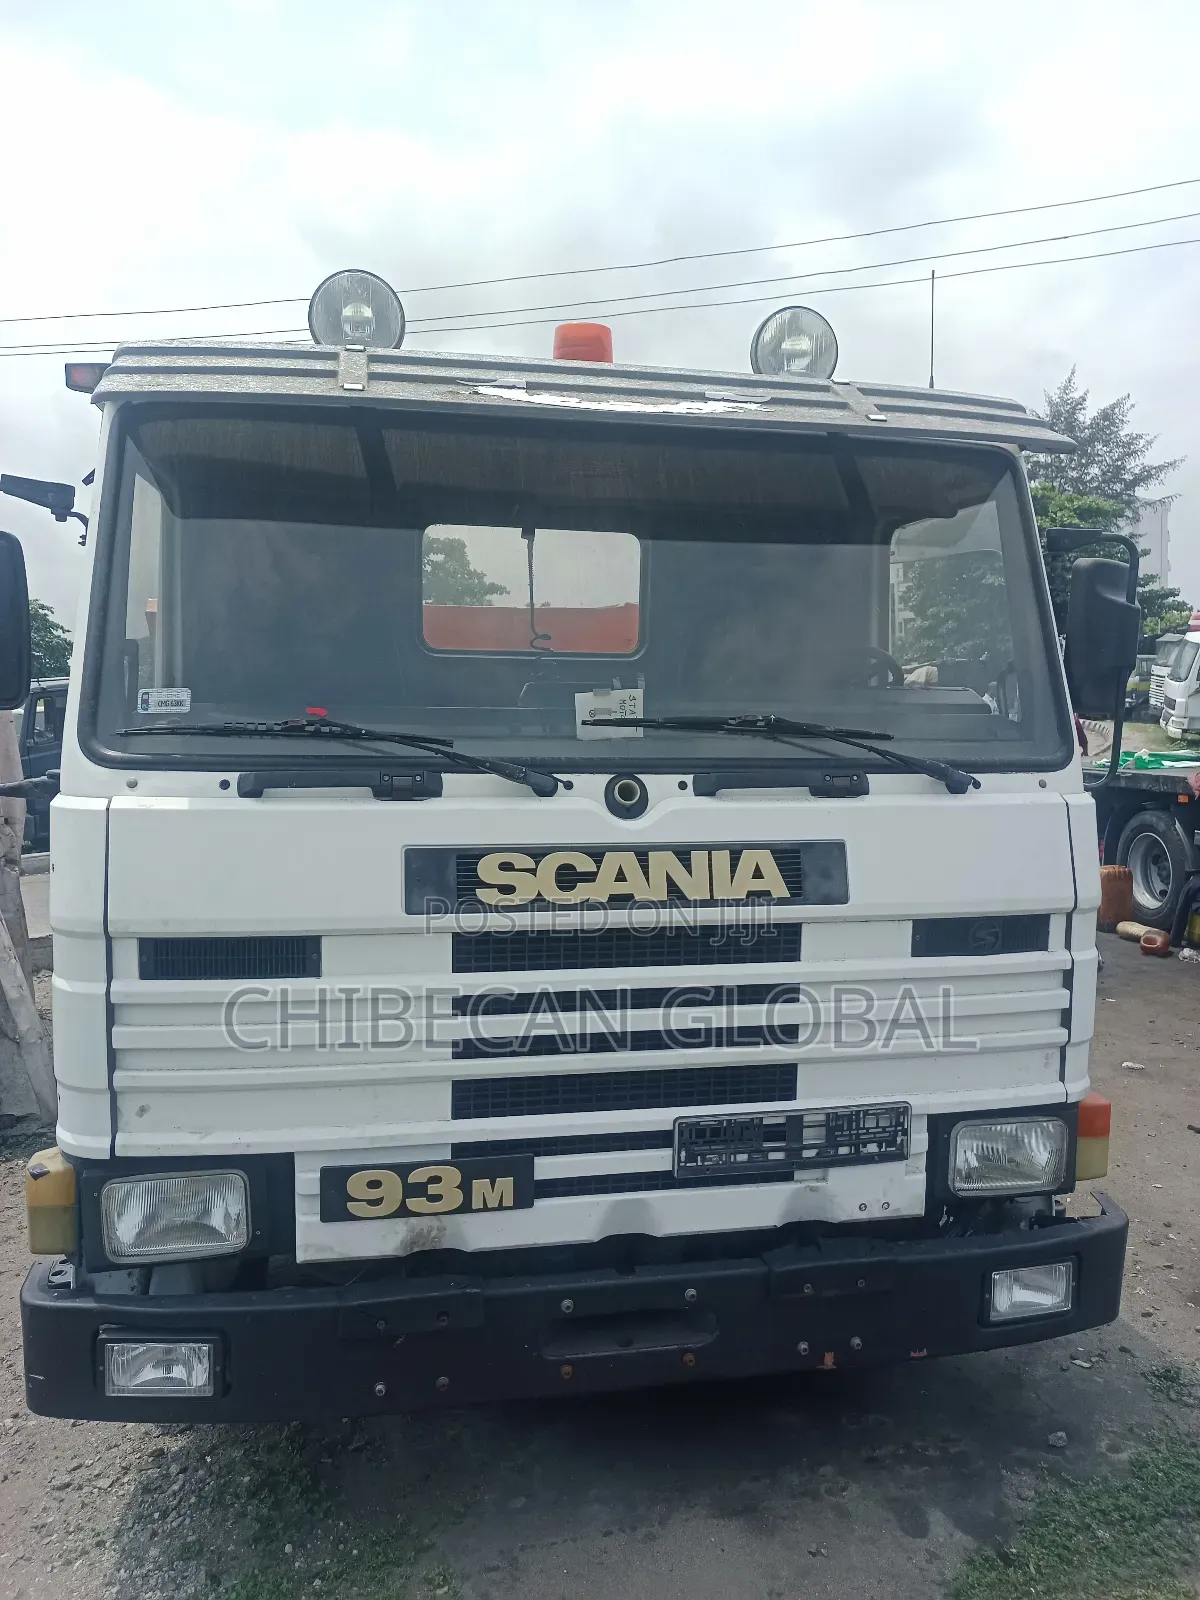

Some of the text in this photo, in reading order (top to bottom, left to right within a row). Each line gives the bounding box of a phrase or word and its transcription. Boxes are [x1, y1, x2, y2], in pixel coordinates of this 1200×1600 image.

[475, 849, 791, 907] SCANIA
[346, 1165, 514, 1218] 93 M
